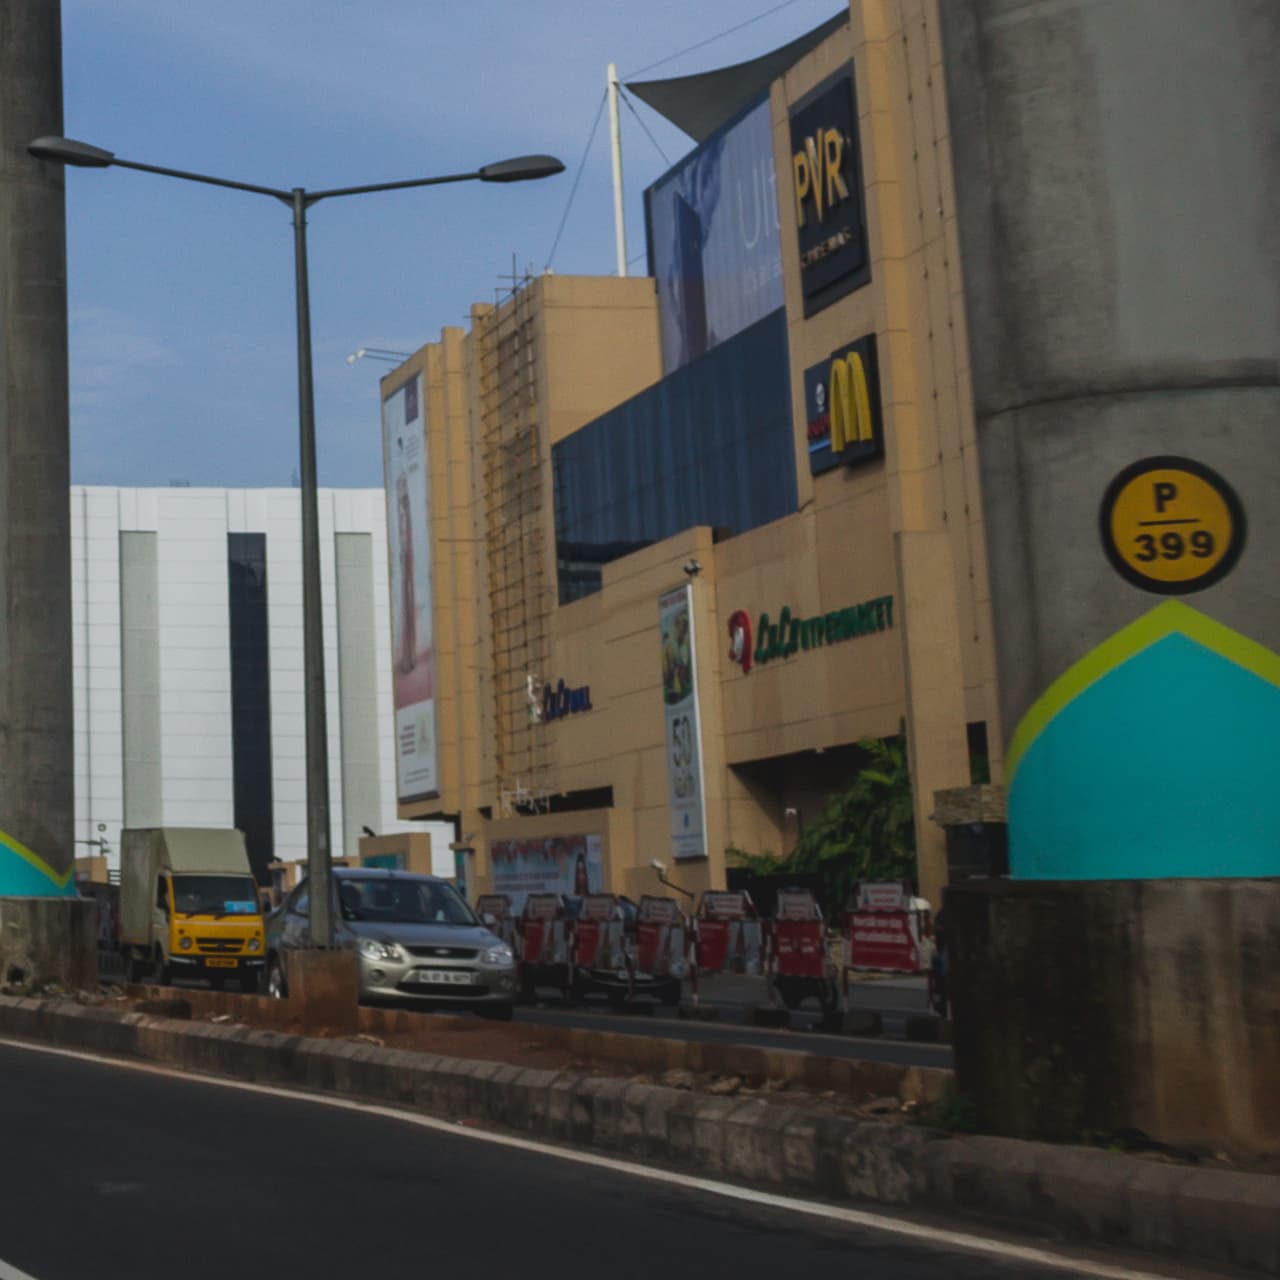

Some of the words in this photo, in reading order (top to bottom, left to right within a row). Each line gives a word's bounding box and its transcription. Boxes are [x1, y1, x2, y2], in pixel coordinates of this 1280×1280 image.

[793, 127, 849, 228] PVR
[1153, 483, 1177, 512] P
[1134, 530, 1215, 562] 399
